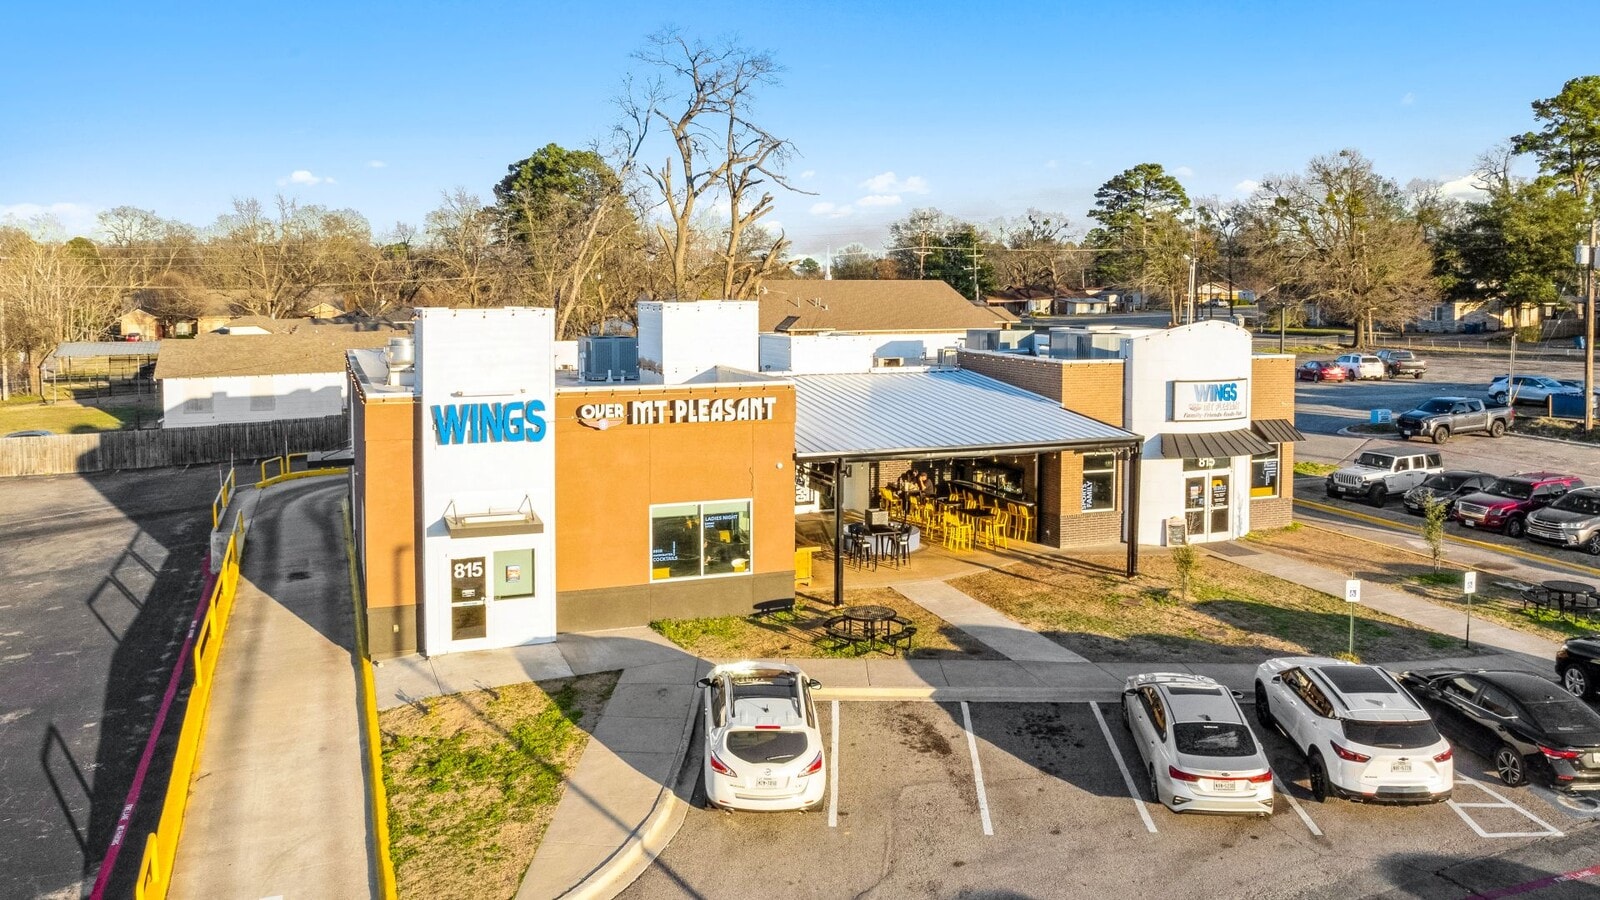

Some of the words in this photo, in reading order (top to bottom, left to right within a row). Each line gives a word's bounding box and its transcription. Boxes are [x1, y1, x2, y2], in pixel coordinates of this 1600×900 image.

[1194, 383, 1237, 402] WINGS
[581, 404, 624, 419] OVER
[630, 401, 668, 425] MT
[674, 397, 777, 423] PLEASANT
[430, 399, 547, 445] WINGS
[1199, 457, 1215, 468] 815
[454, 562, 483, 579] 815
